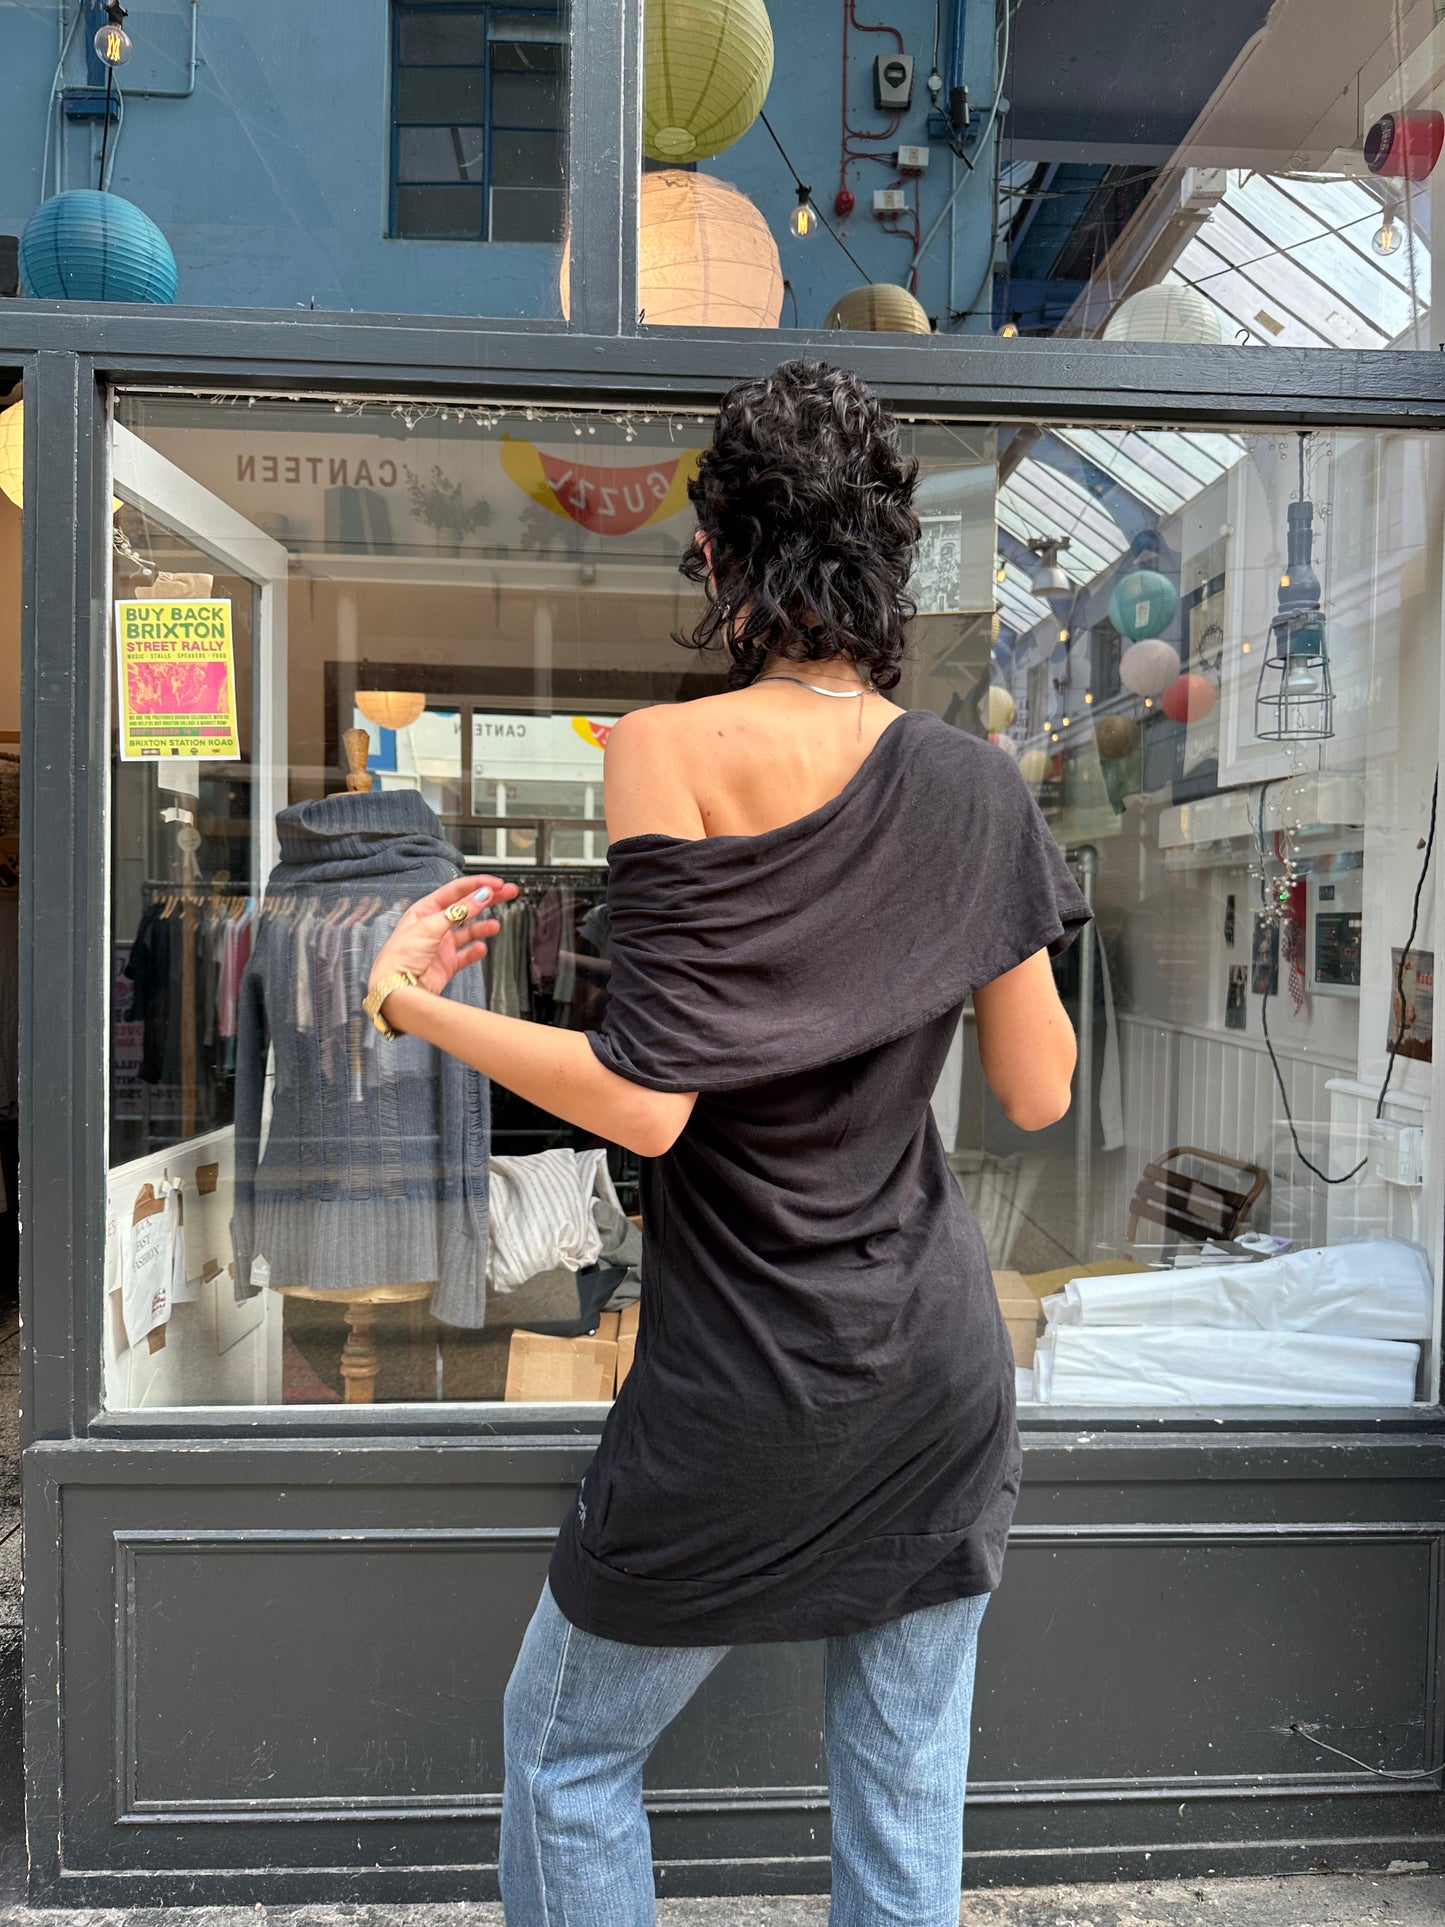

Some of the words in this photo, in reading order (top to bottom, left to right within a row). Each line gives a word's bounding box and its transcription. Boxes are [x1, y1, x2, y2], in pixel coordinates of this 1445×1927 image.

[126, 607, 165, 622] BUY
[171, 606, 224, 621] BACK
[126, 622, 225, 639] BRIXTON
[126, 641, 177, 652] STREET
[182, 640, 224, 651] RALLY
